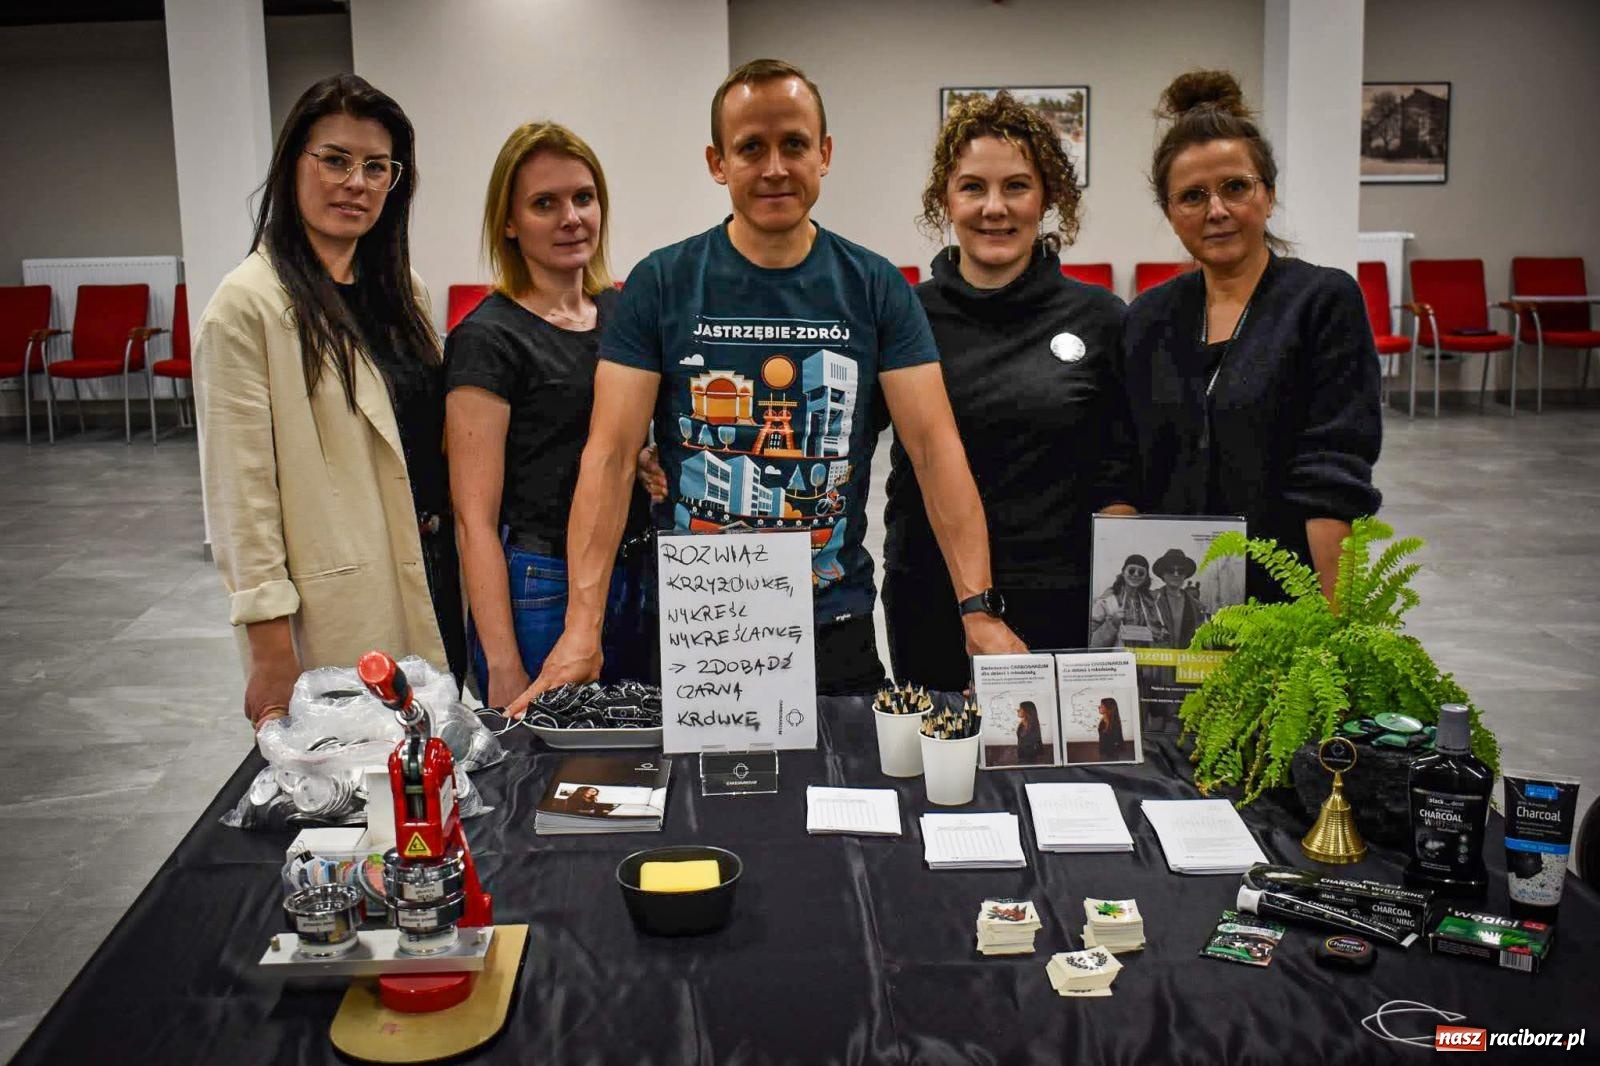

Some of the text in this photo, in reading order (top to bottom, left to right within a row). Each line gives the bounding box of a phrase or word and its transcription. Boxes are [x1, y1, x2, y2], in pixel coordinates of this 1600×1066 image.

[693, 323, 850, 340] JASTRZĘBIE-ZDRÓJ
[697, 652, 793, 676] ZDOBĄDŹ
[676, 682, 743, 701] CZARNĄ
[676, 710, 761, 731] KRÓWKĘ
[1419, 809, 1462, 823] CHARCOAL
[1516, 806, 1561, 821] Charcoal
[1320, 878, 1367, 890] CHARCOAL
[1371, 904, 1412, 918] CHARCOAL
